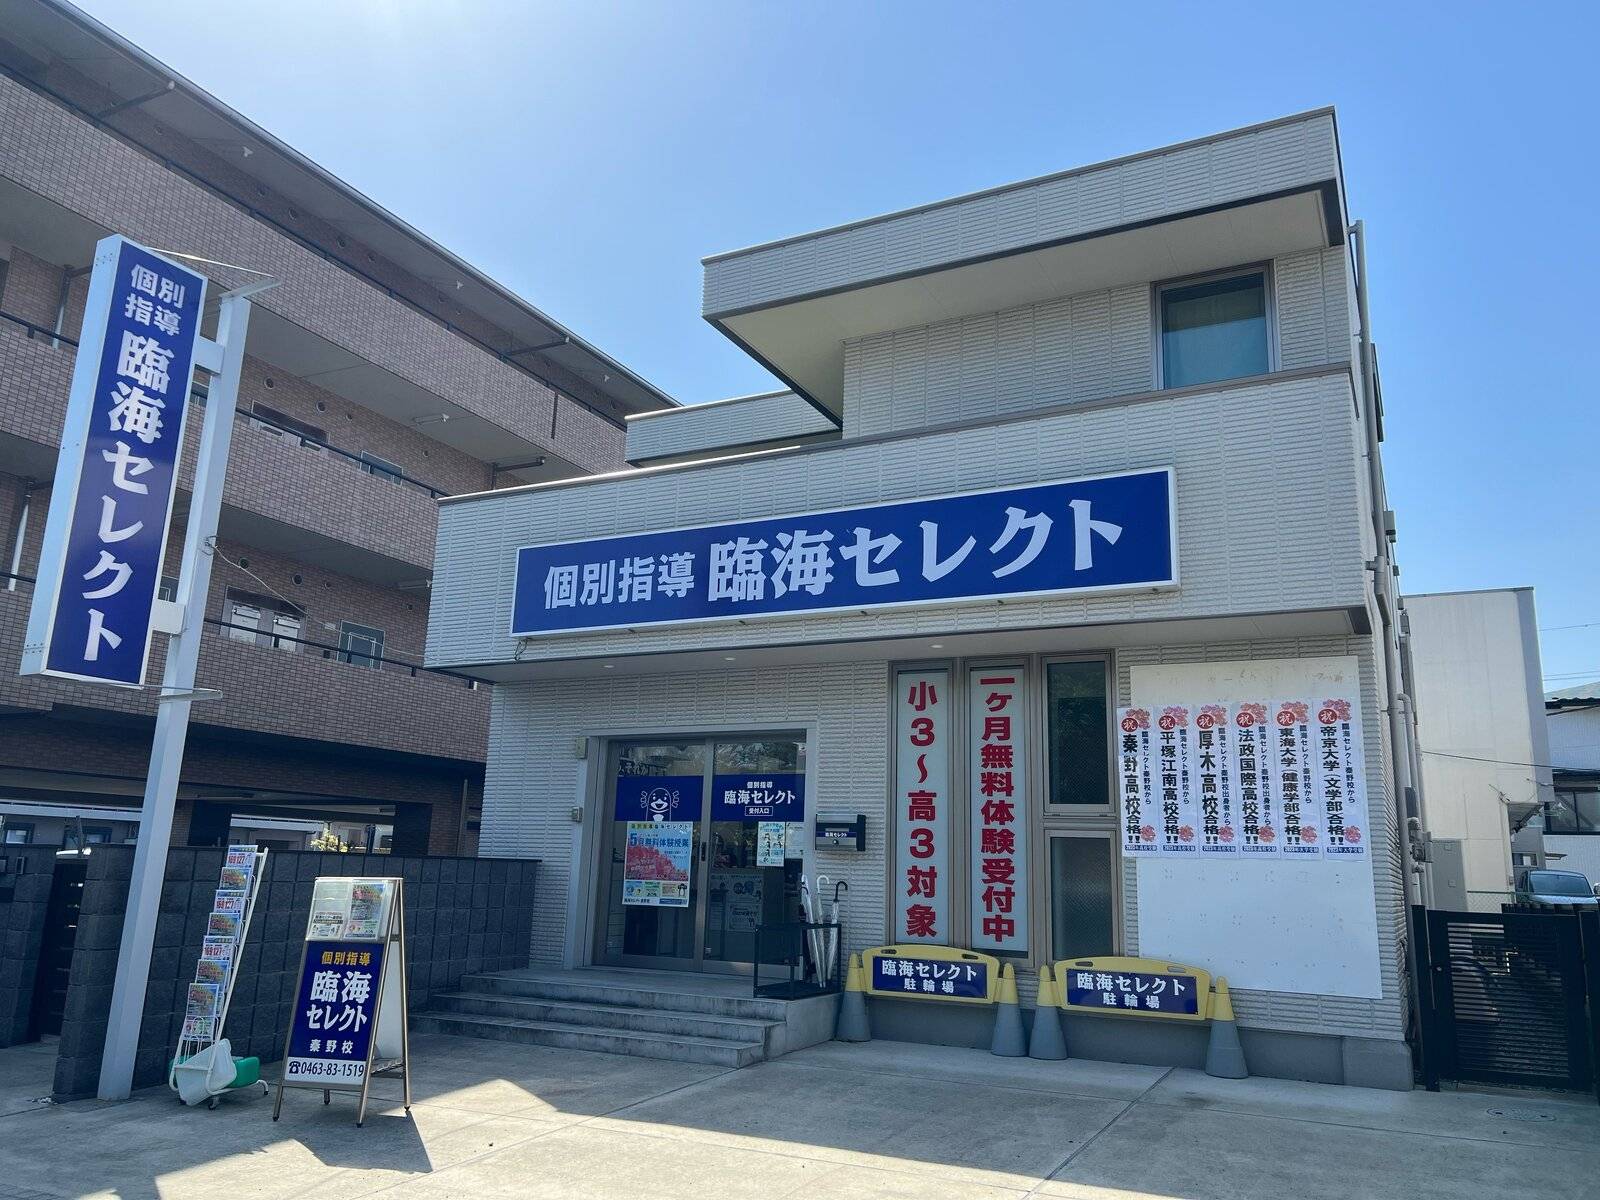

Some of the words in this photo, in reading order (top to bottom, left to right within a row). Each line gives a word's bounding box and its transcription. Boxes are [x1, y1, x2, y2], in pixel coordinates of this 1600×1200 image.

[131, 263, 185, 308] 個別
[125, 293, 181, 336] 指導
[82, 330, 174, 661] 臨海セレクト
[544, 553, 695, 610] 個別指導
[708, 499, 1122, 602] 臨海セレクト
[1123, 719, 1136, 730] 祝
[1161, 717, 1173, 728] 祝
[1199, 716, 1212, 727] 祝
[1239, 714, 1252, 726] 祝
[1279, 713, 1293, 725] 祝
[1321, 711, 1335, 723] 祝
[747, 781, 773, 789] 個別指導
[724, 790, 796, 804] 臨海セレクト
[322, 951, 371, 966] 個別指導
[882, 959, 978, 981] 臨海セレクト
[310, 970, 372, 1004] 臨海
[904, 978, 954, 994] 駐輪場
[1077, 972, 1185, 998] 臨海セレクト
[1103, 992, 1160, 1009] 駐輪場
[306, 1004, 368, 1032] セレクト
[309, 1039, 354, 1054] 秦野校
[301, 1061, 365, 1077] 0463-83-1519
